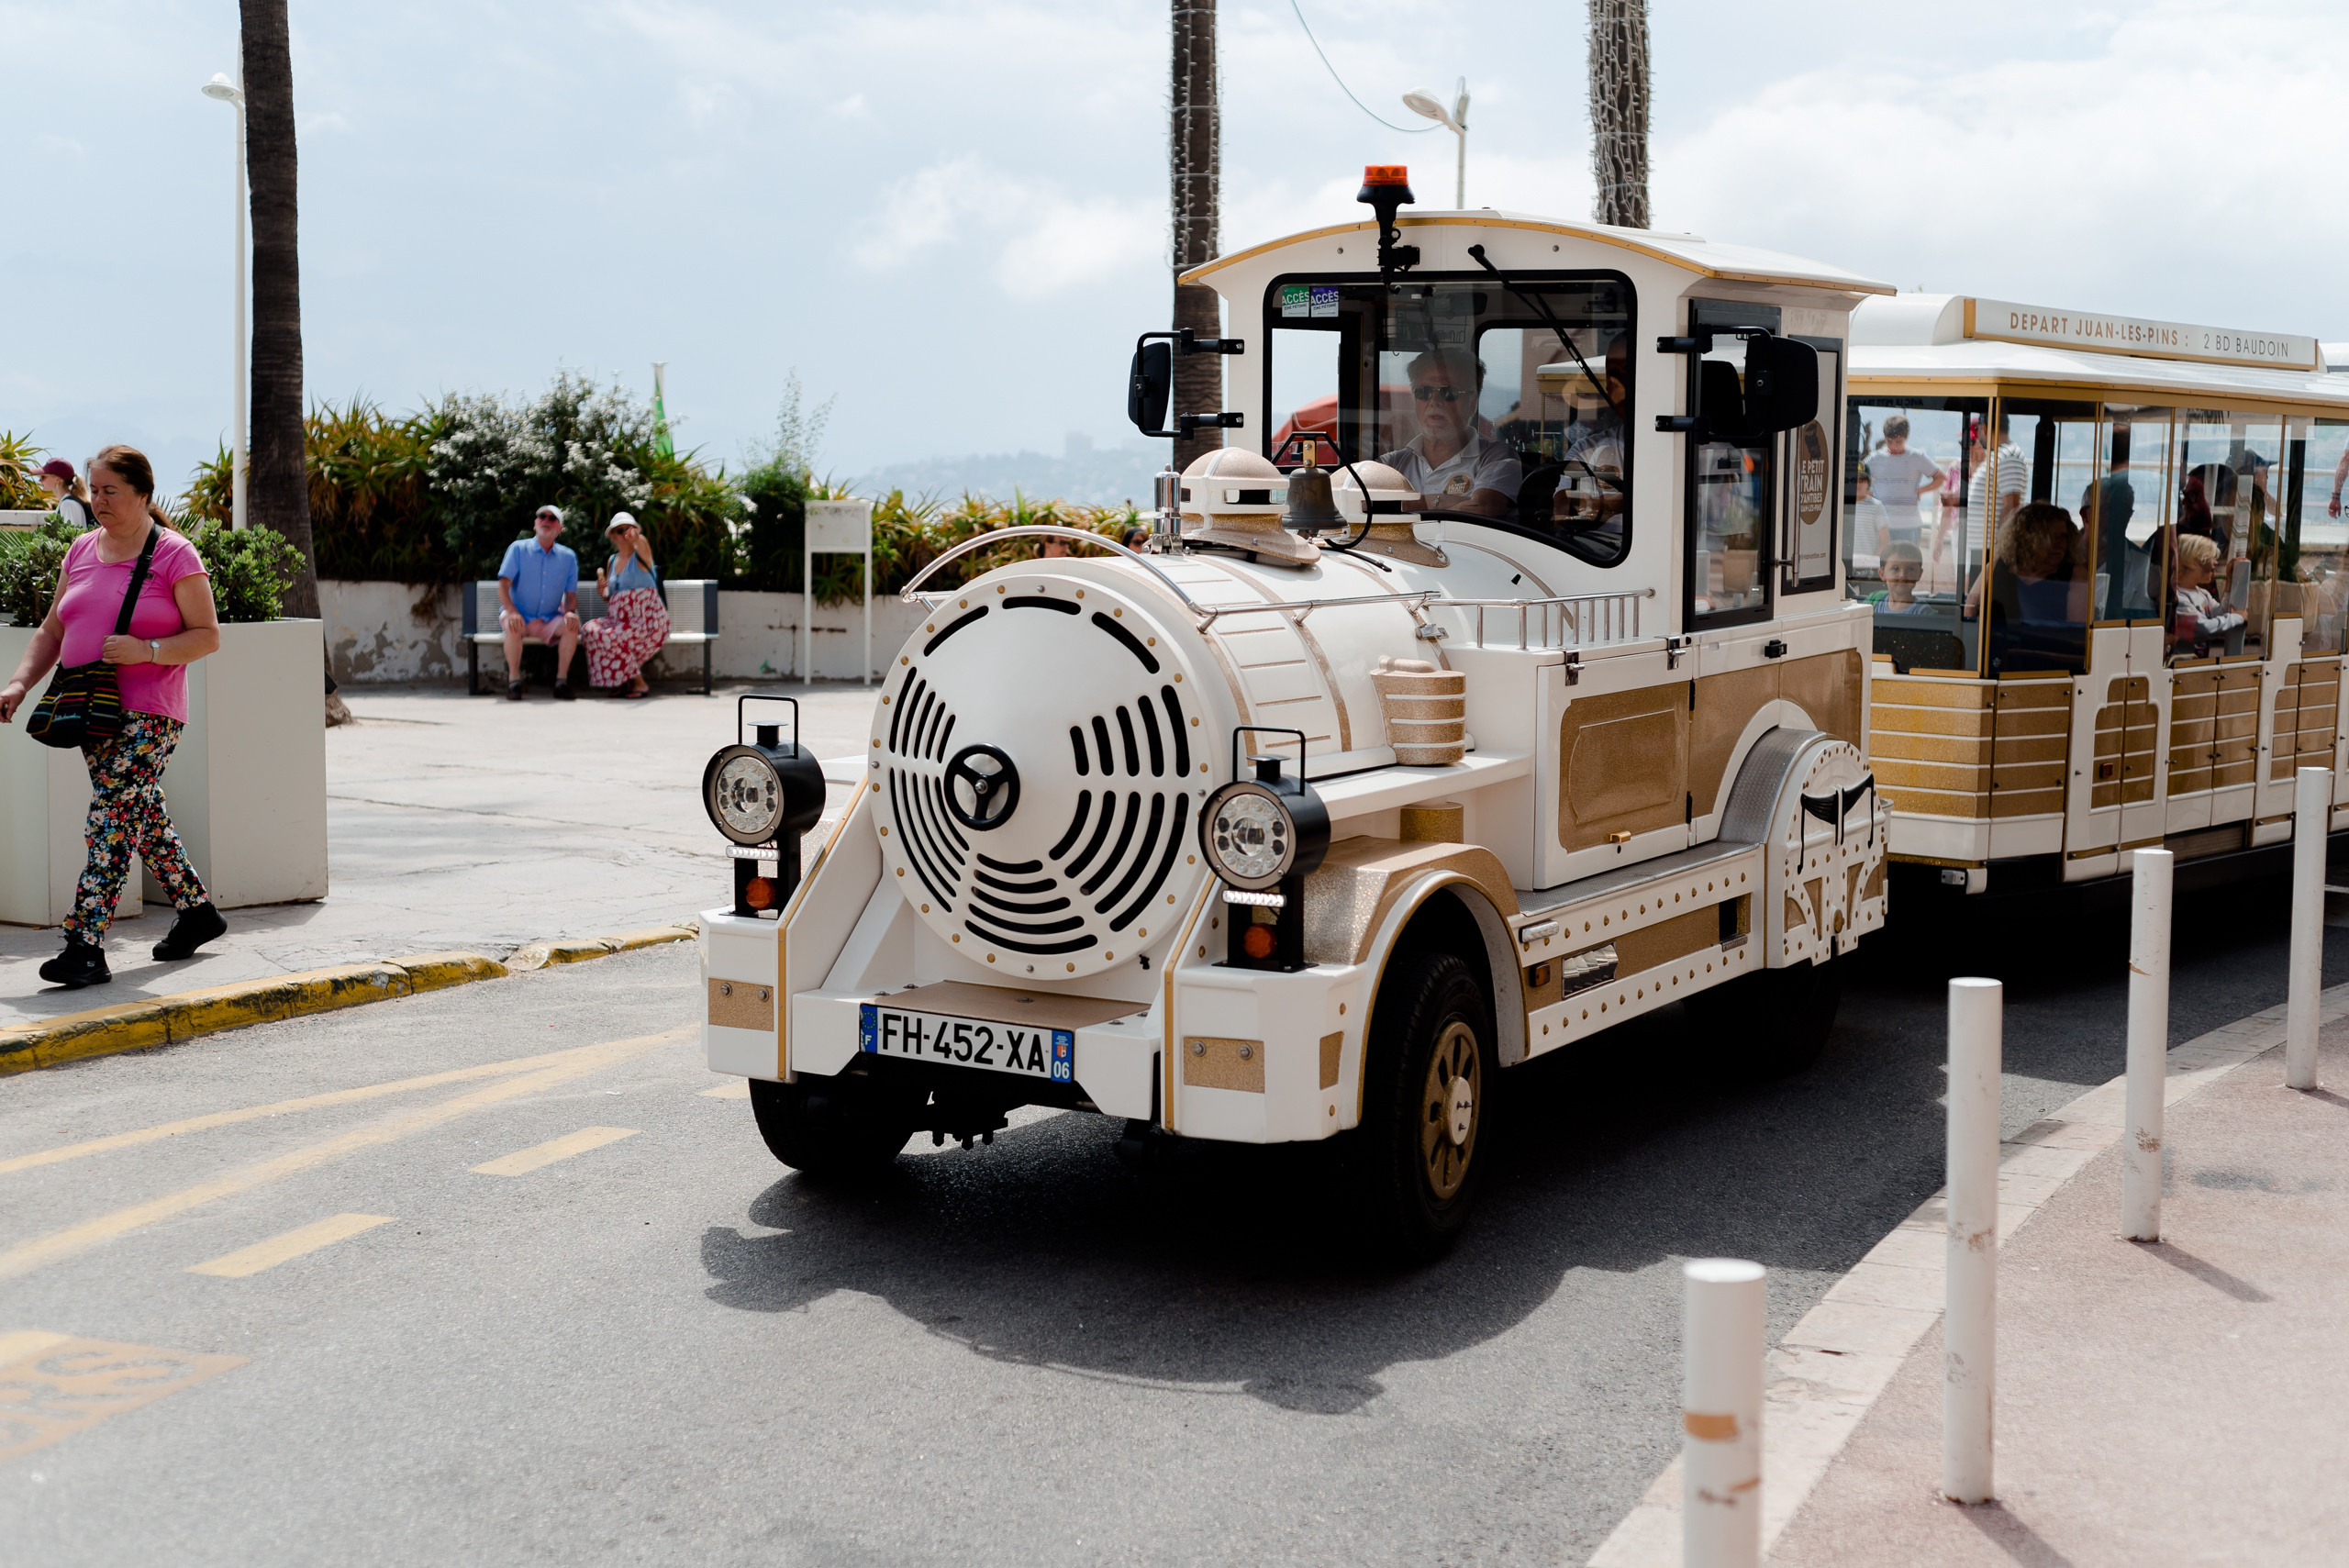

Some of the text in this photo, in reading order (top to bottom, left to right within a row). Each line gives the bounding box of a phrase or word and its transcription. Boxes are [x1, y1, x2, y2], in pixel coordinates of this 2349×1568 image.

[1282, 290, 1309, 305] ACCÈS
[1311, 290, 1339, 305] ACCÈS
[2009, 312, 2068, 334] DEPART
[2076, 319, 2178, 346] JUAN-LES-PINS
[2204, 333, 2210, 350] 2
[2216, 335, 2231, 351] BD
[2236, 338, 2289, 358] BAUDOIN
[1808, 459, 1825, 474] PETIT
[864, 1013, 1046, 1073] F FH-452-XA
[1053, 1060, 1070, 1080] 06
